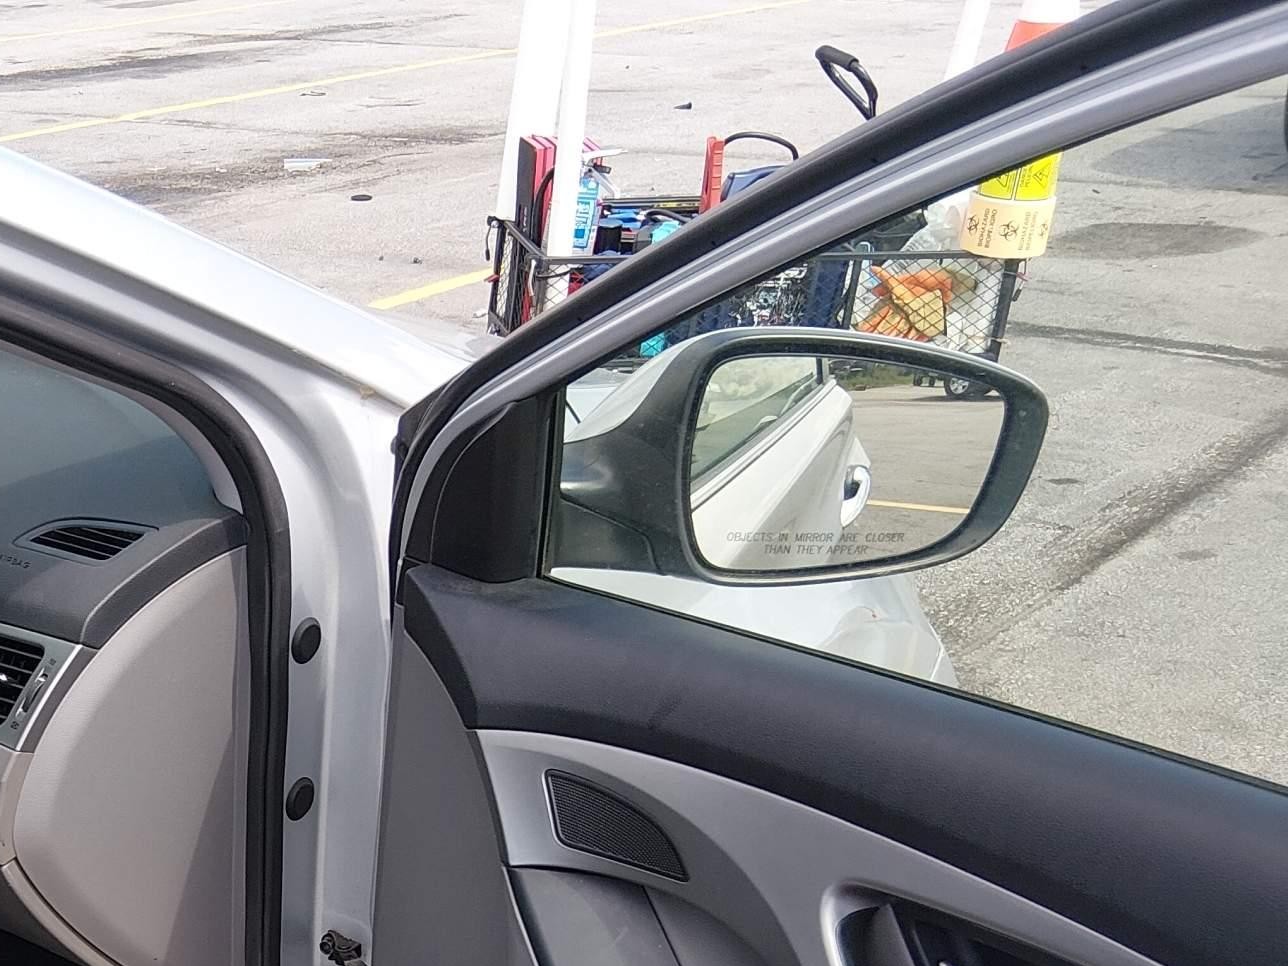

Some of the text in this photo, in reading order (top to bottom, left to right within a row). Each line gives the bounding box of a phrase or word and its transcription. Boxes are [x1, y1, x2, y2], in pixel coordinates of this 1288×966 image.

[977, 208, 990, 246] BIOHAZARD
[726, 531, 905, 543] OBJECTS IN MIRROR ARE CLOSER
[764, 544, 869, 555] THAN THEY APPEAR
